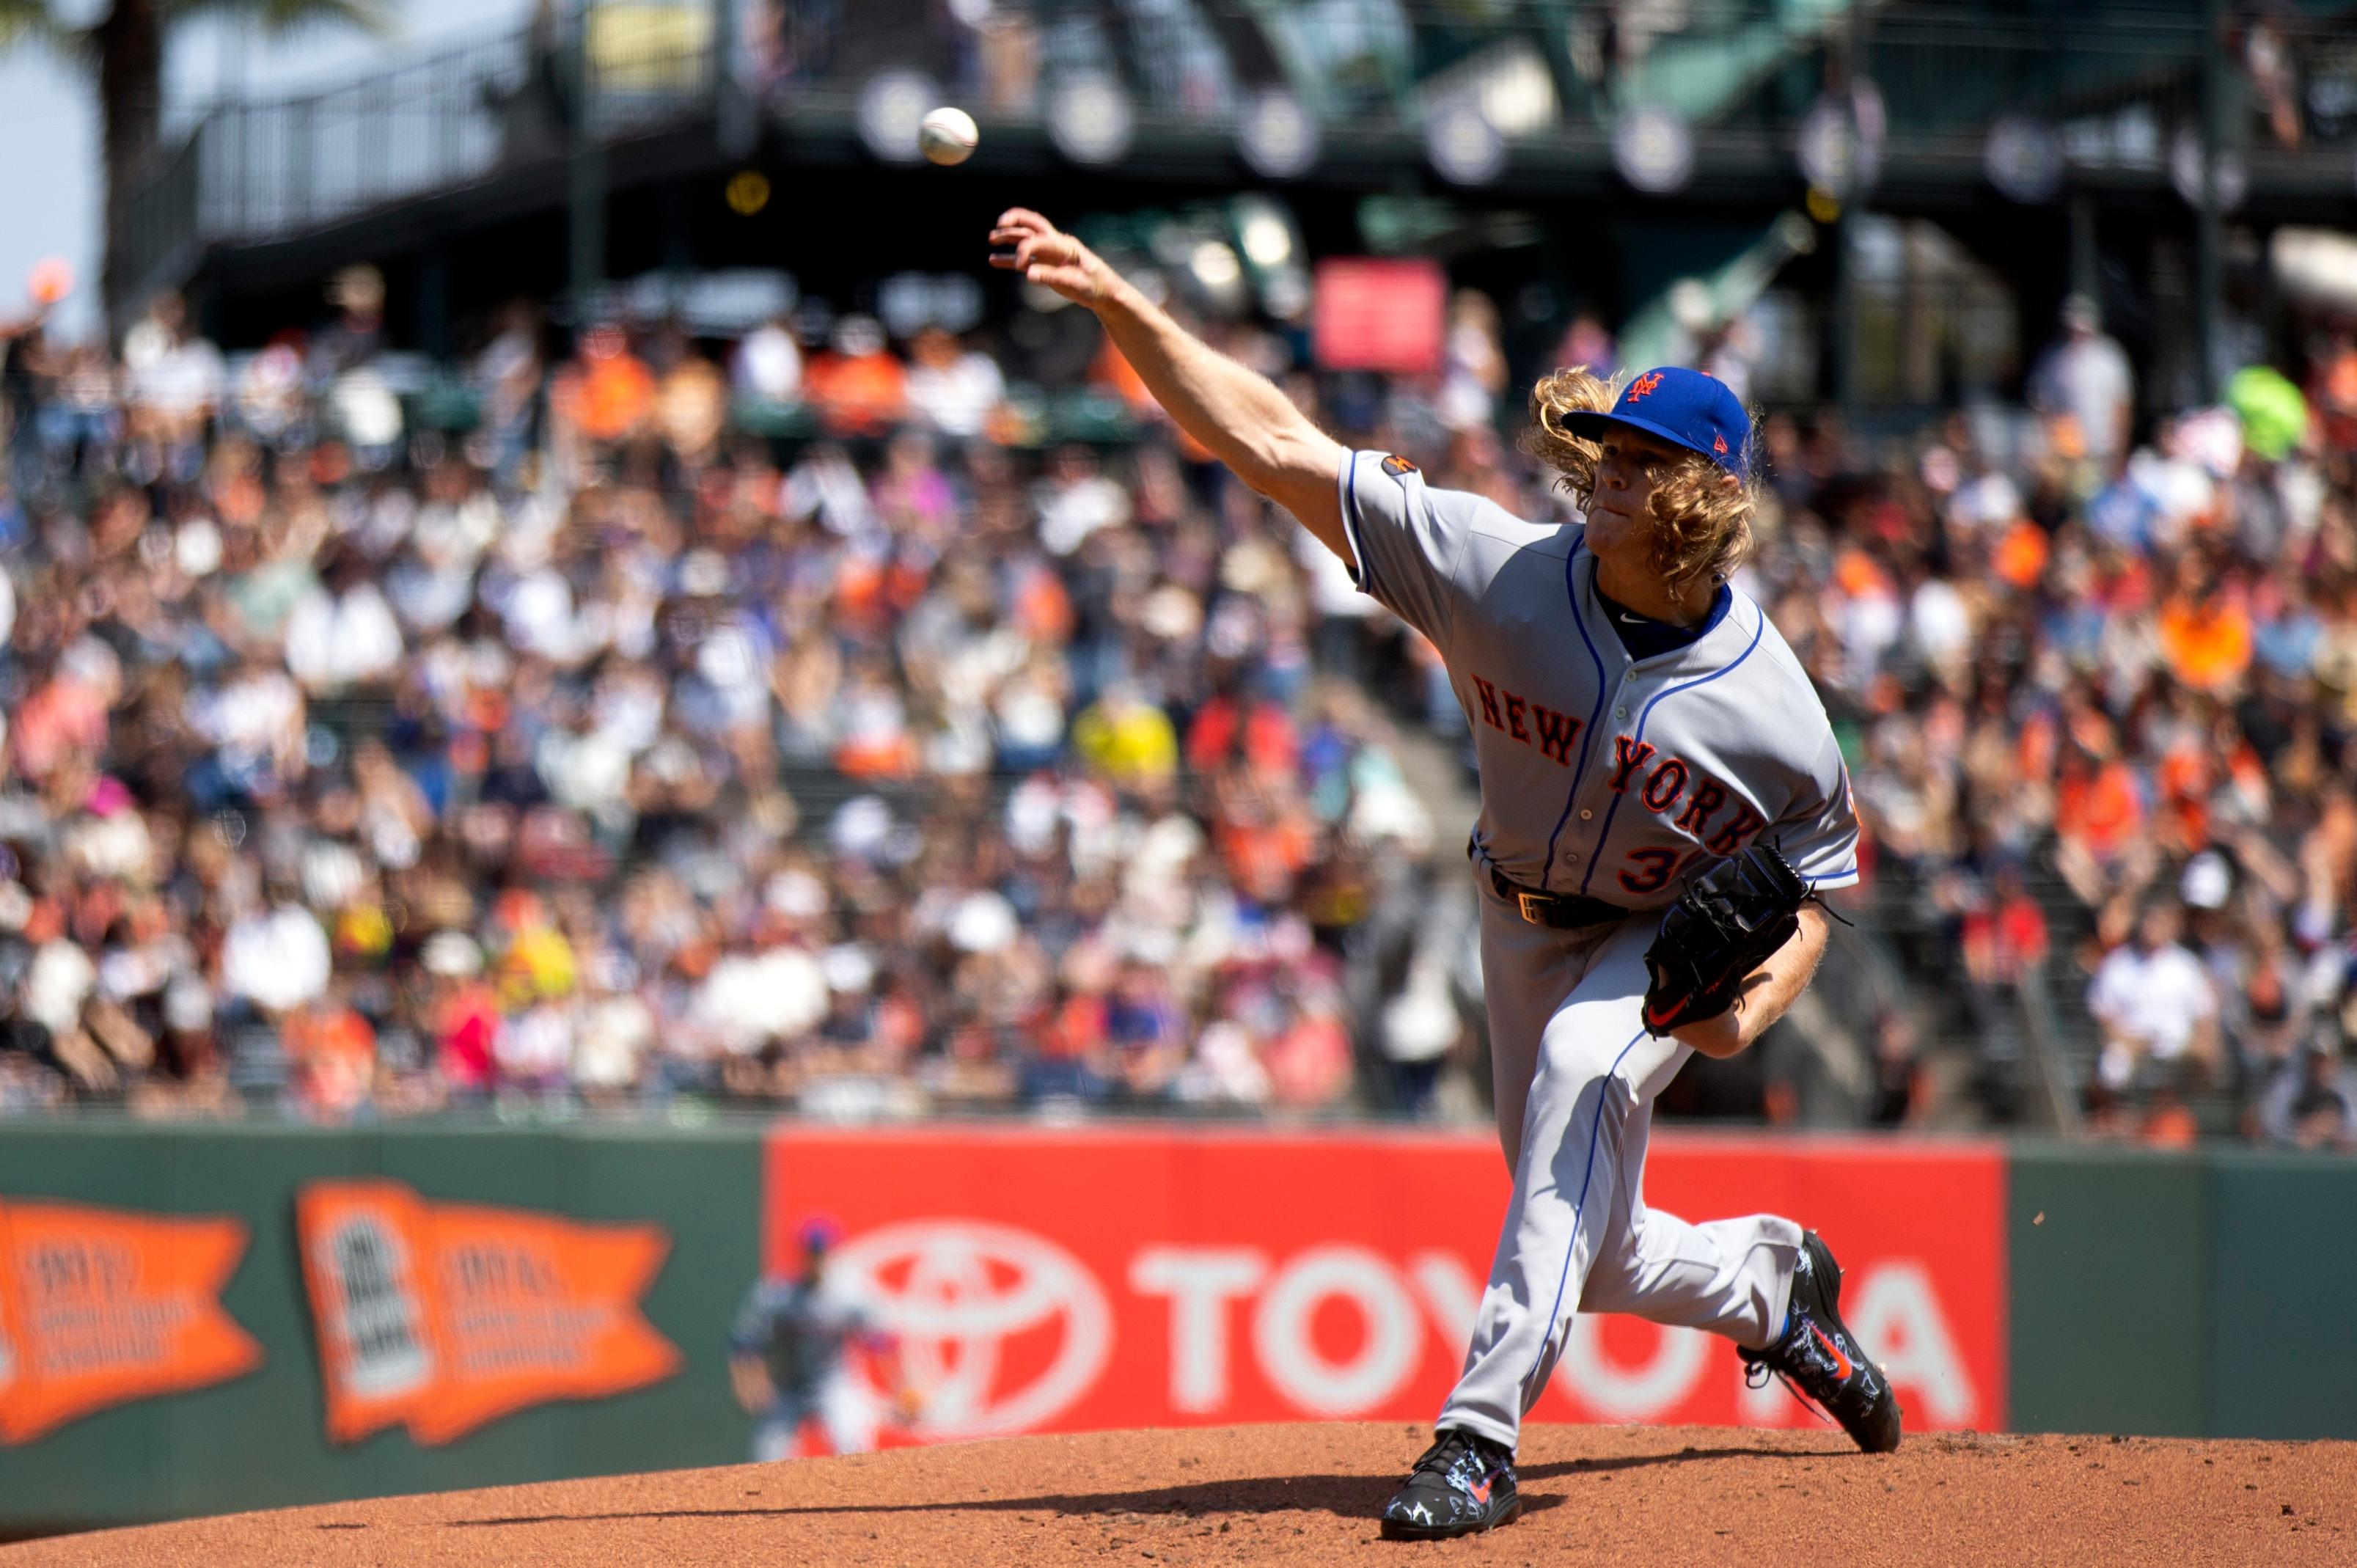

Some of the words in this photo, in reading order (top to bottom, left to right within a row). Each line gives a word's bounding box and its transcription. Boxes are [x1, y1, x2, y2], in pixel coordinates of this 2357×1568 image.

[1471, 674, 1585, 766] NEW
[1608, 736, 1766, 856] YORK
[1617, 846, 1698, 895] 3
[1130, 1245, 1976, 1425] TOOA
